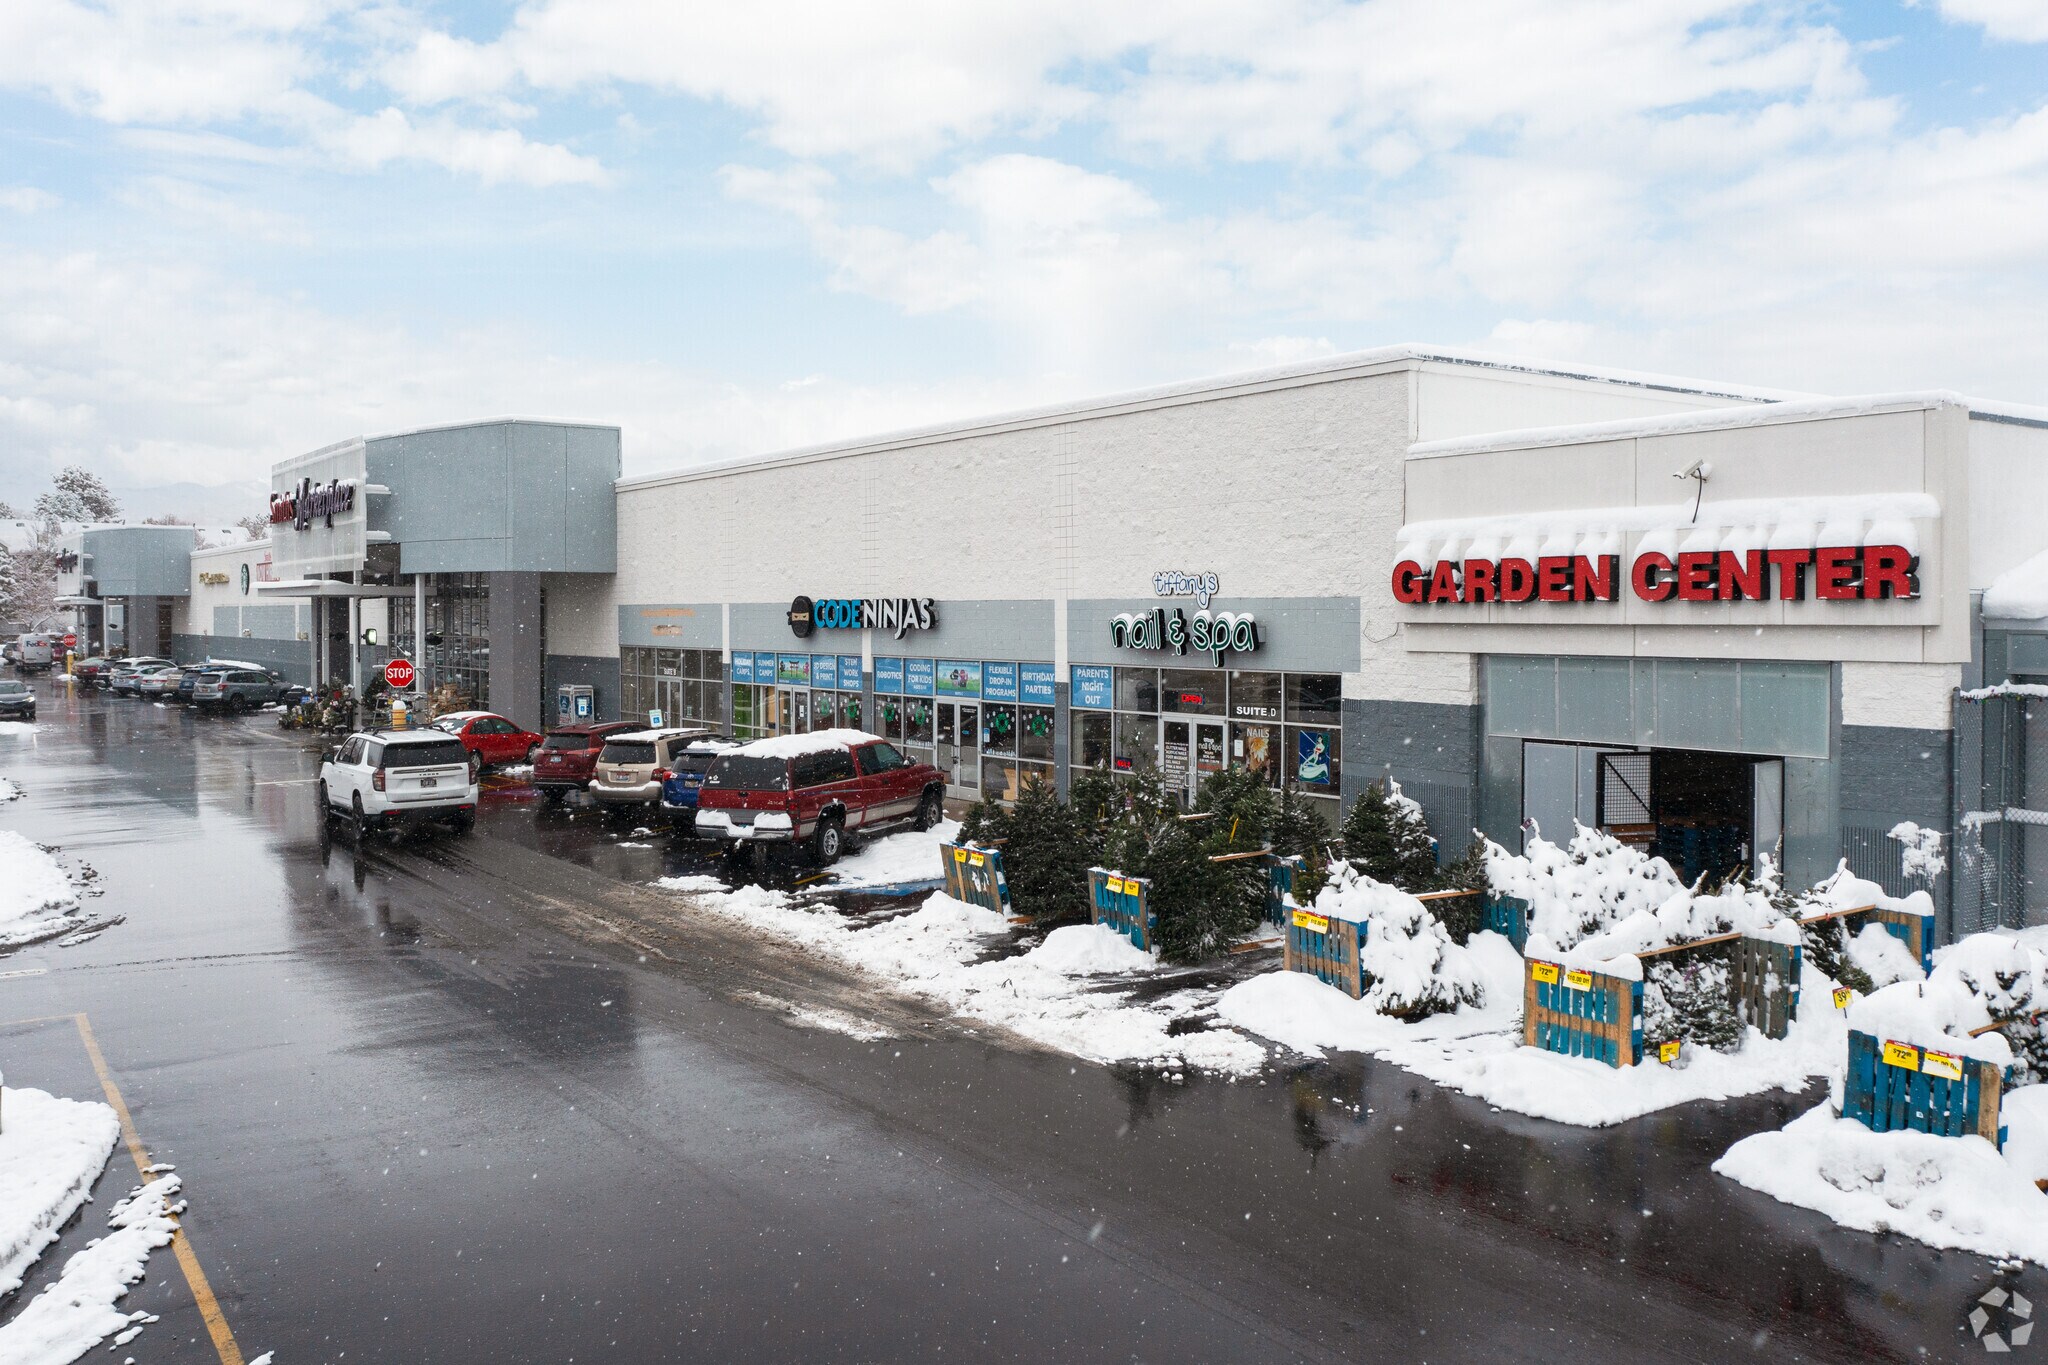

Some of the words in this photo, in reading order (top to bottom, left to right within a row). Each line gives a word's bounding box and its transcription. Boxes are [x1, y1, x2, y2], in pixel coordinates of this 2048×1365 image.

[1392, 554, 1619, 604] GARDEN
[1632, 544, 1920, 602] CENTER
[1153, 572, 1218, 608] tiffany's
[814, 599, 862, 629] CODE
[863, 598, 935, 640] NINJAS
[1110, 608, 1165, 650] nail
[1168, 608, 1189, 656] &
[1192, 616, 1258, 667] spa
[757, 659, 775, 667] SUMMER
[909, 663, 931, 673] CODING
[387, 667, 413, 679] STOP
[758, 669, 773, 677] CAMPS
[843, 669, 859, 677] WORK
[877, 671, 902, 680] ROBOTICS
[988, 665, 1013, 675] FLEXIBLE
[1076, 668, 1109, 679] PARENTS
[907, 674, 919, 684] FOR
[919, 675, 932, 684] KIDS
[989, 676, 1012, 686] DROP-IN
[1022, 671, 1054, 682] BIRTHDAY
[843, 680, 860, 688] SHOPS
[1024, 684, 1052, 695] PARTIES
[1081, 681, 1105, 692] NIGHT
[985, 687, 1016, 697] PROGRAMS
[1084, 695, 1101, 705] OUT
[1181, 693, 1203, 704] OPEN
[1236, 706, 1268, 717] SUITE
[1270, 707, 1277, 717] D
[1246, 727, 1270, 738] NAILS
